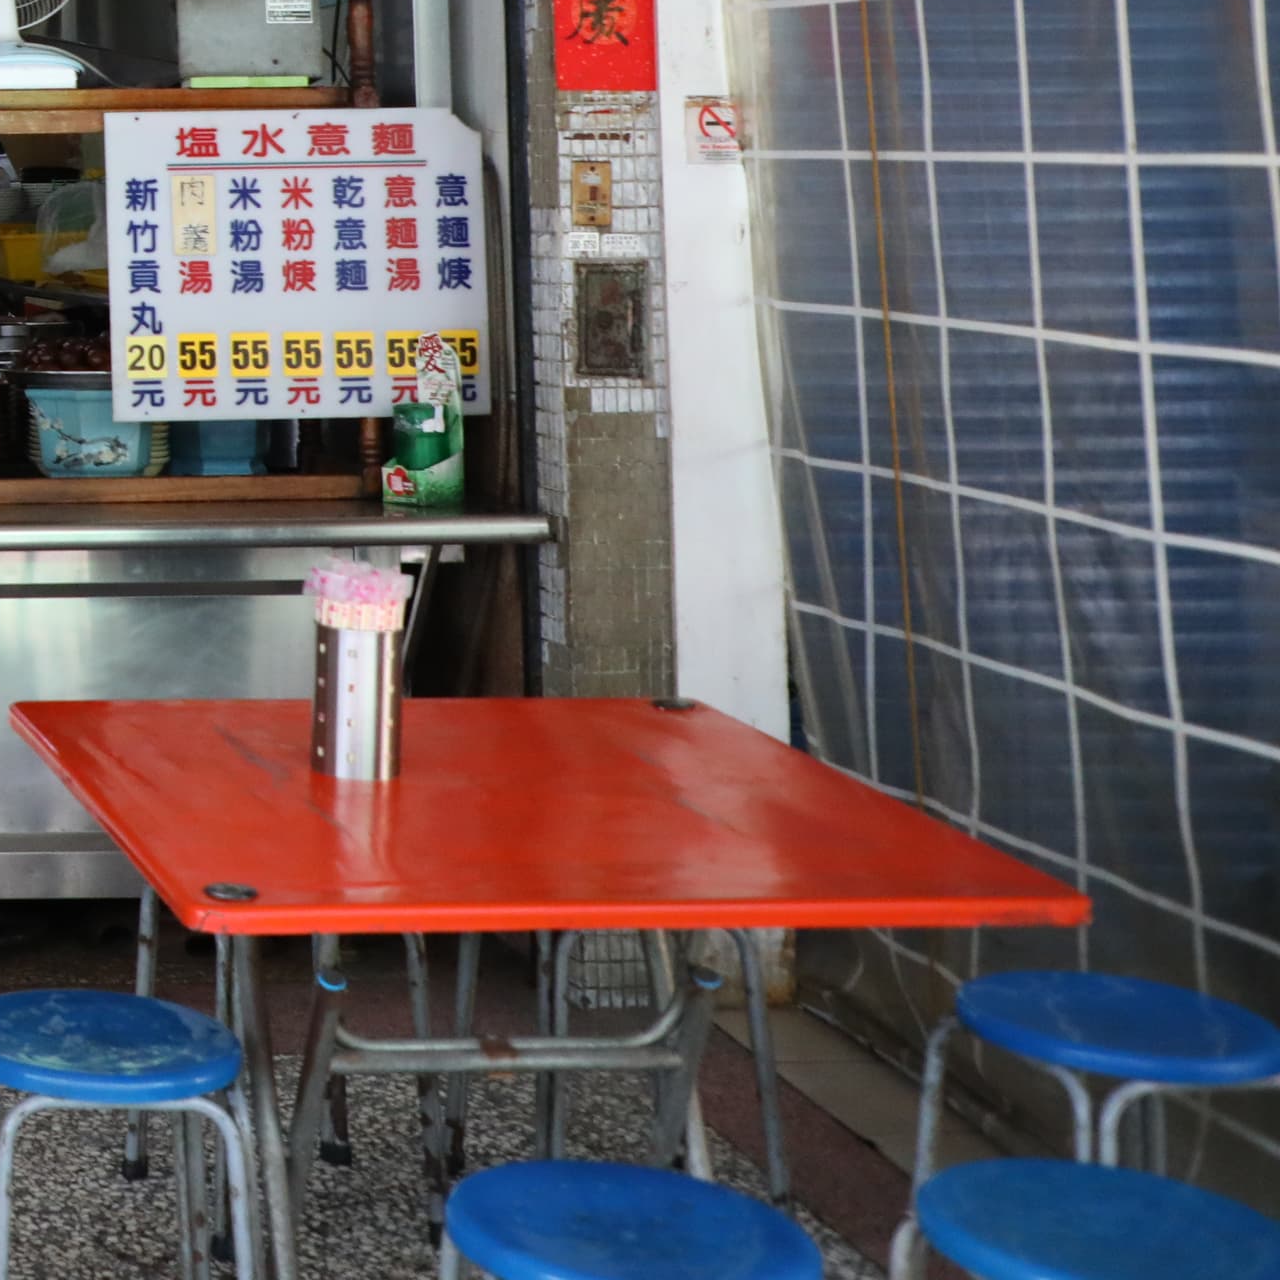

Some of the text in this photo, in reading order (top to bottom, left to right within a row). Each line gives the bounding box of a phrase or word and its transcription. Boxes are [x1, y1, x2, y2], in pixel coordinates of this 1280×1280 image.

[175, 122, 417, 158] 塩水意麵
[384, 174, 421, 293] 意麵湯
[124, 177, 166, 408] 新竹貢丸 20 元
[228, 176, 269, 406] 米粉湯 55 元
[332, 175, 373, 404] 乾意麵 55 元
[179, 340, 216, 370] 55
[285, 339, 321, 369] 55
[183, 379, 217, 407] 元
[287, 377, 321, 405] 元
